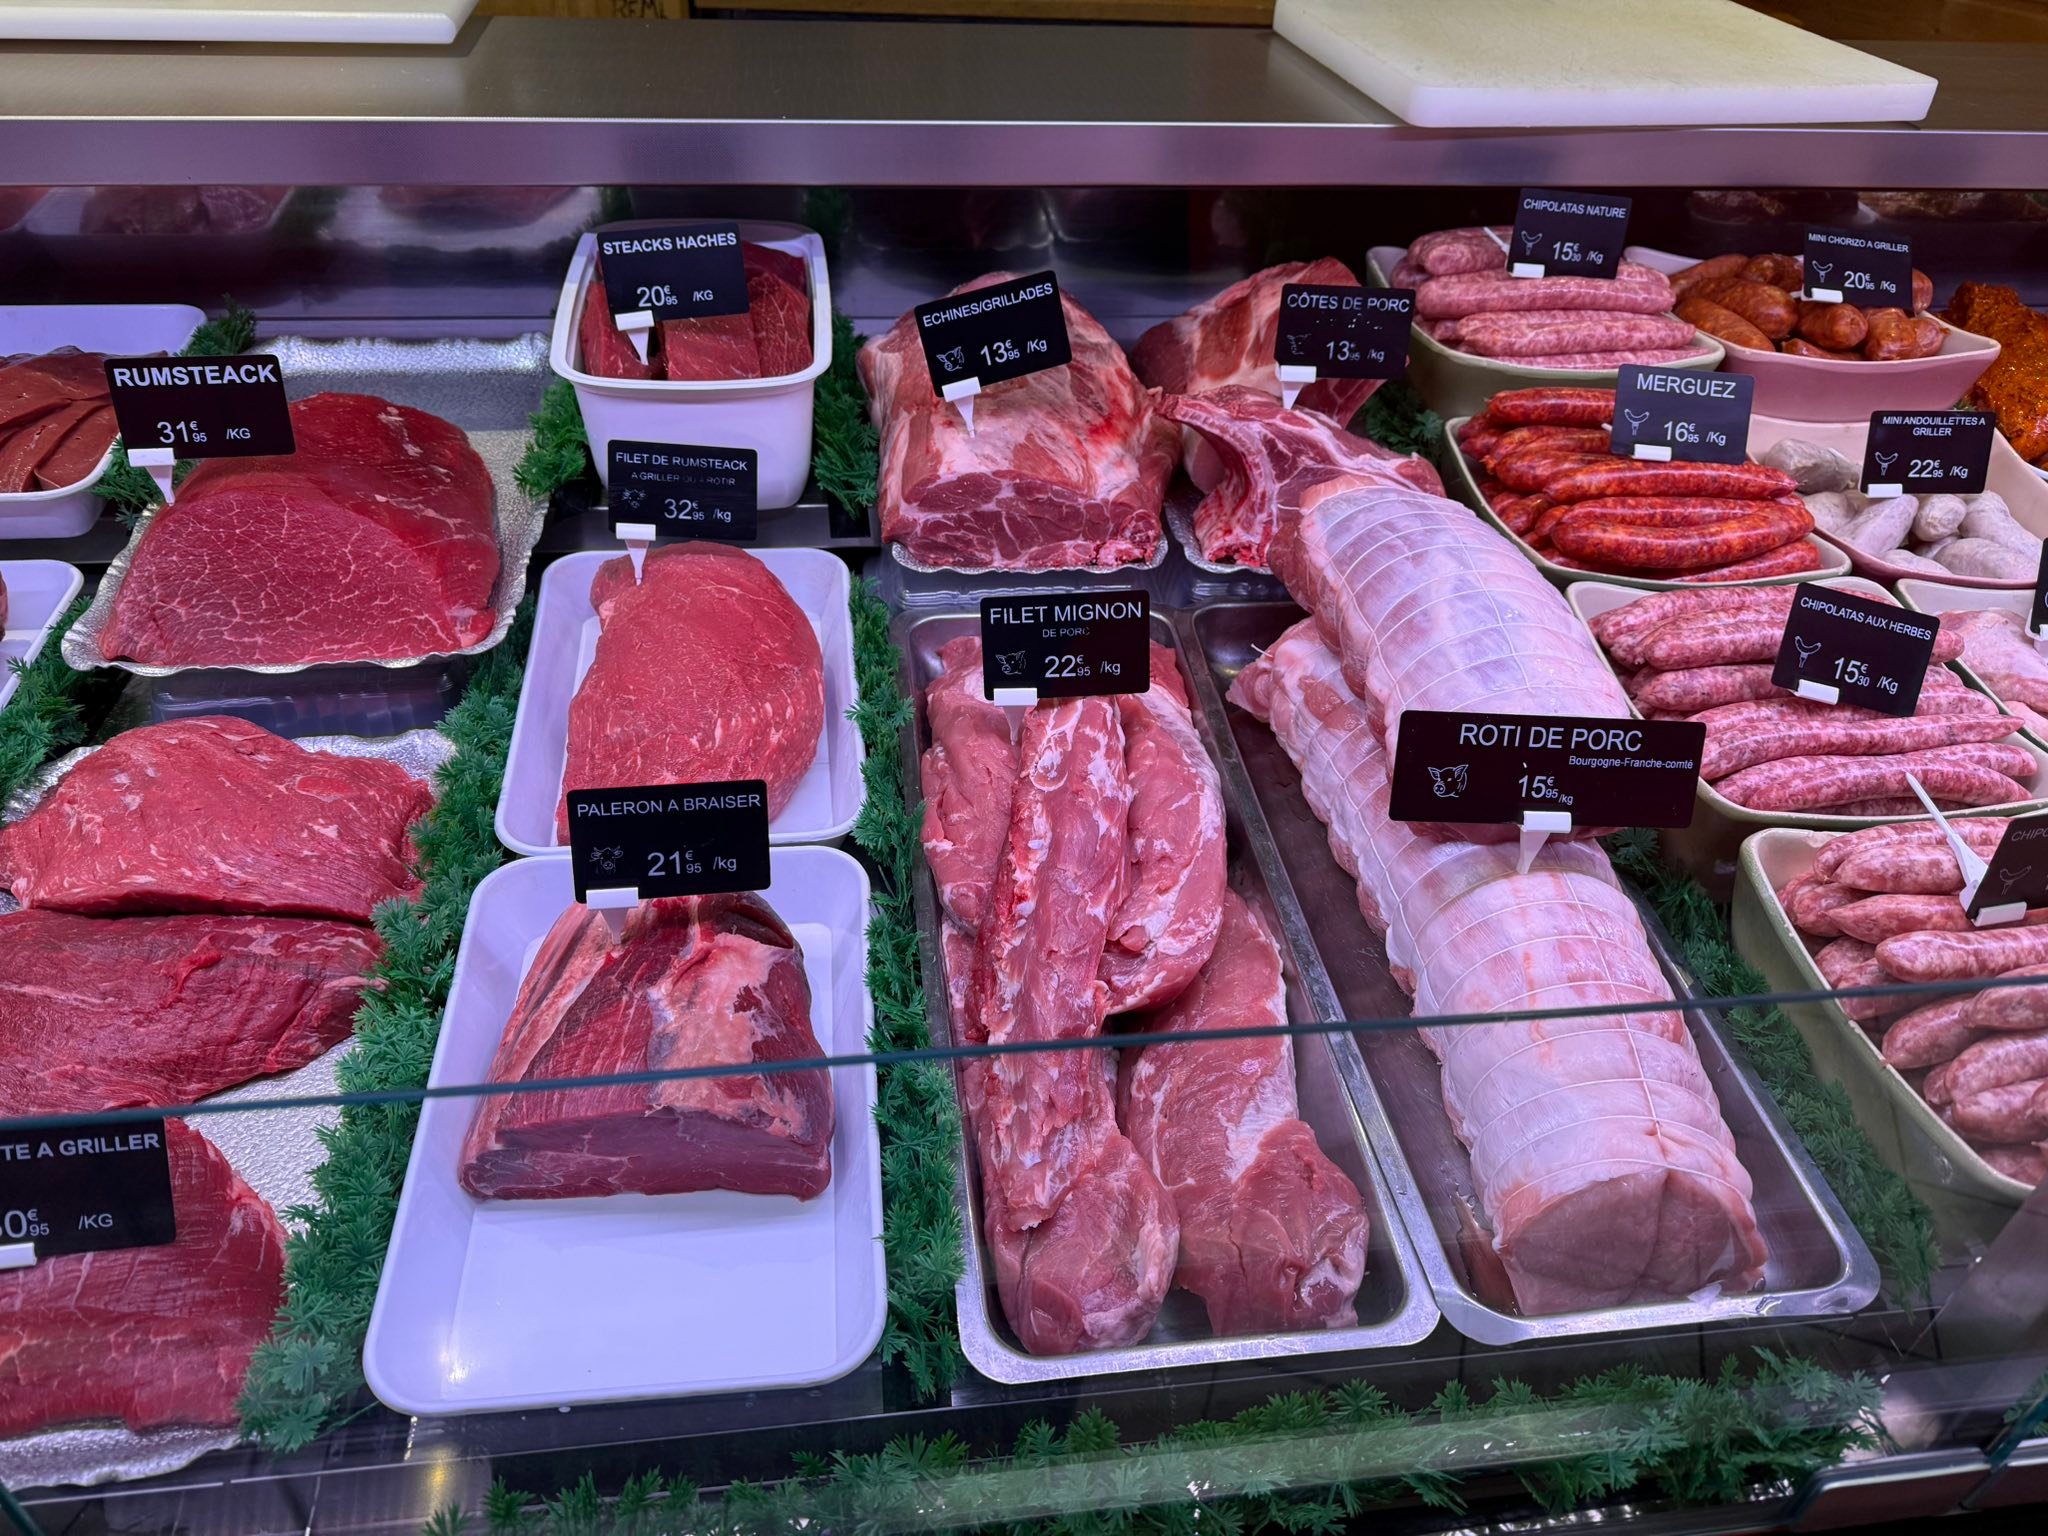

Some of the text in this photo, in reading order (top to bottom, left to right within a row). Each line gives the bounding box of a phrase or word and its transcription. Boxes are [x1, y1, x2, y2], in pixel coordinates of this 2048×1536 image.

[1523, 198, 1627, 219] CHIPOLATAS NATURE
[603, 232, 737, 255] STEACKS HACHES
[1808, 233, 1909, 252] MINI CHORIZO A GRILLER
[1586, 251, 1604, 265] /Kg
[1880, 281, 1896, 293] /Kg
[693, 290, 714, 302] /KG
[1287, 292, 1410, 312] CÔTES DE PORC
[923, 283, 1053, 327] ECHINES/GRILLADES
[1027, 339, 1047, 354] /Kg
[1367, 348, 1384, 363] /kg
[113, 364, 278, 387] RUMSTEACK
[1637, 373, 1736, 399] MERGUEZ
[1882, 416, 1986, 425] MINI ANDOUILLETTES A
[226, 428, 251, 440] /KG
[1706, 431, 1726, 446] /Kg
[1912, 427, 1952, 436] GRILLER
[616, 452, 748, 471] FILET DE RUMSTEACK
[631, 471, 638, 479] A
[639, 472, 680, 482] GRILLER
[1950, 466, 1968, 479] /Kg
[713, 508, 732, 523] /kg
[990, 602, 1142, 625] FILET MIGNON
[1800, 597, 1932, 641] CHIPOLATAS AUX HERBES
[1042, 626, 1090, 638] DE PORC
[1100, 661, 1121, 675] /kg
[1877, 676, 1899, 695] /Kg
[1459, 723, 1643, 751] ROTI DE PORC
[1569, 755, 1693, 770] Bourgogne-Franche-comté
[577, 794, 761, 817] PALERON A BRAISER
[1558, 793, 1574, 805] /kg
[713, 856, 737, 871] /kg
[37, 1142, 54, 1158] A
[59, 1133, 160, 1156] GRILLER
[0, 1208, 113, 1239] 0€95 /KG
